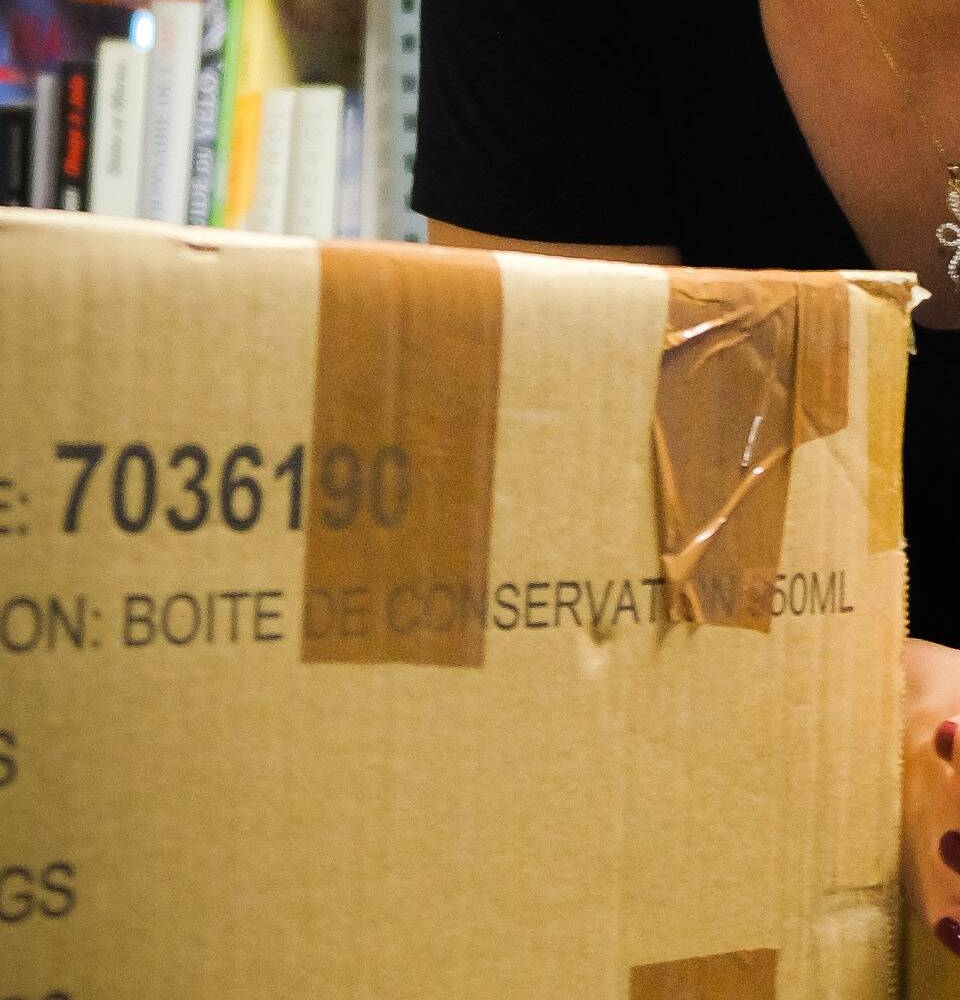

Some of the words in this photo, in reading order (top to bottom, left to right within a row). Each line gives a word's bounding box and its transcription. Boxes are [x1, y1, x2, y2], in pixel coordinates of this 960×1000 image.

[54, 442, 412, 533] 7036190
[122, 592, 284, 648] BOITE
[748, 568, 854, 617] 50ML
